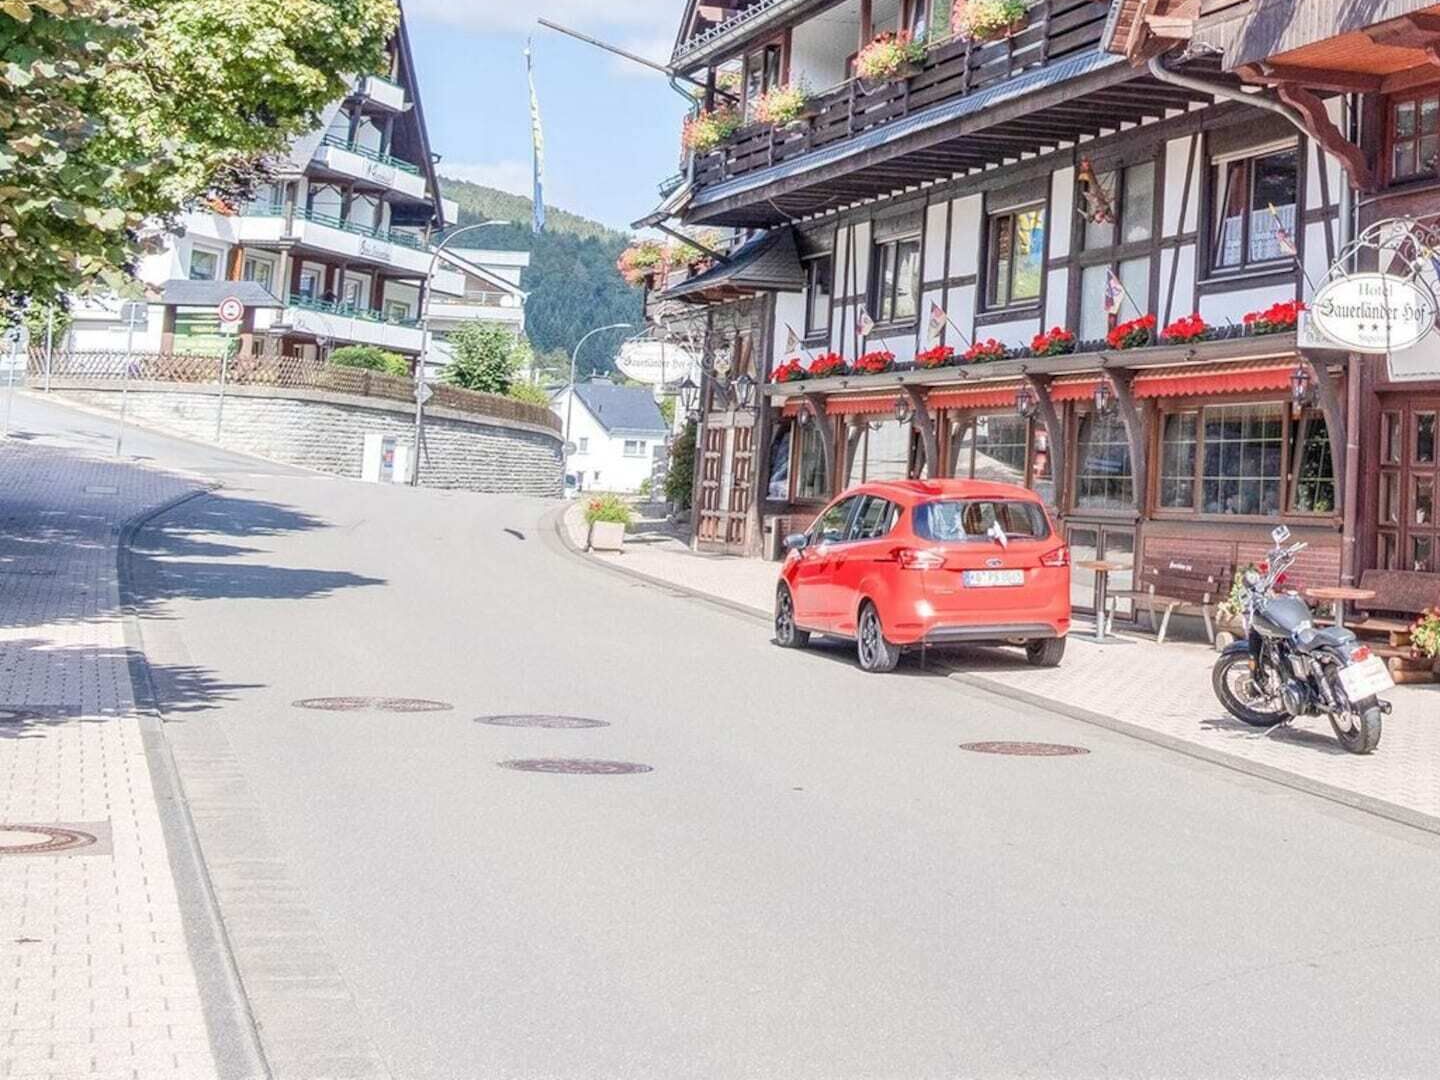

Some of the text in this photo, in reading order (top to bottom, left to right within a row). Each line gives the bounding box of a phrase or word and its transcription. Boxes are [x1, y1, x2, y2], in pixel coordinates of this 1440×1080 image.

[1358, 283, 1393, 296] Hotel
[1320, 297, 1426, 325] Sauerländer Hof
